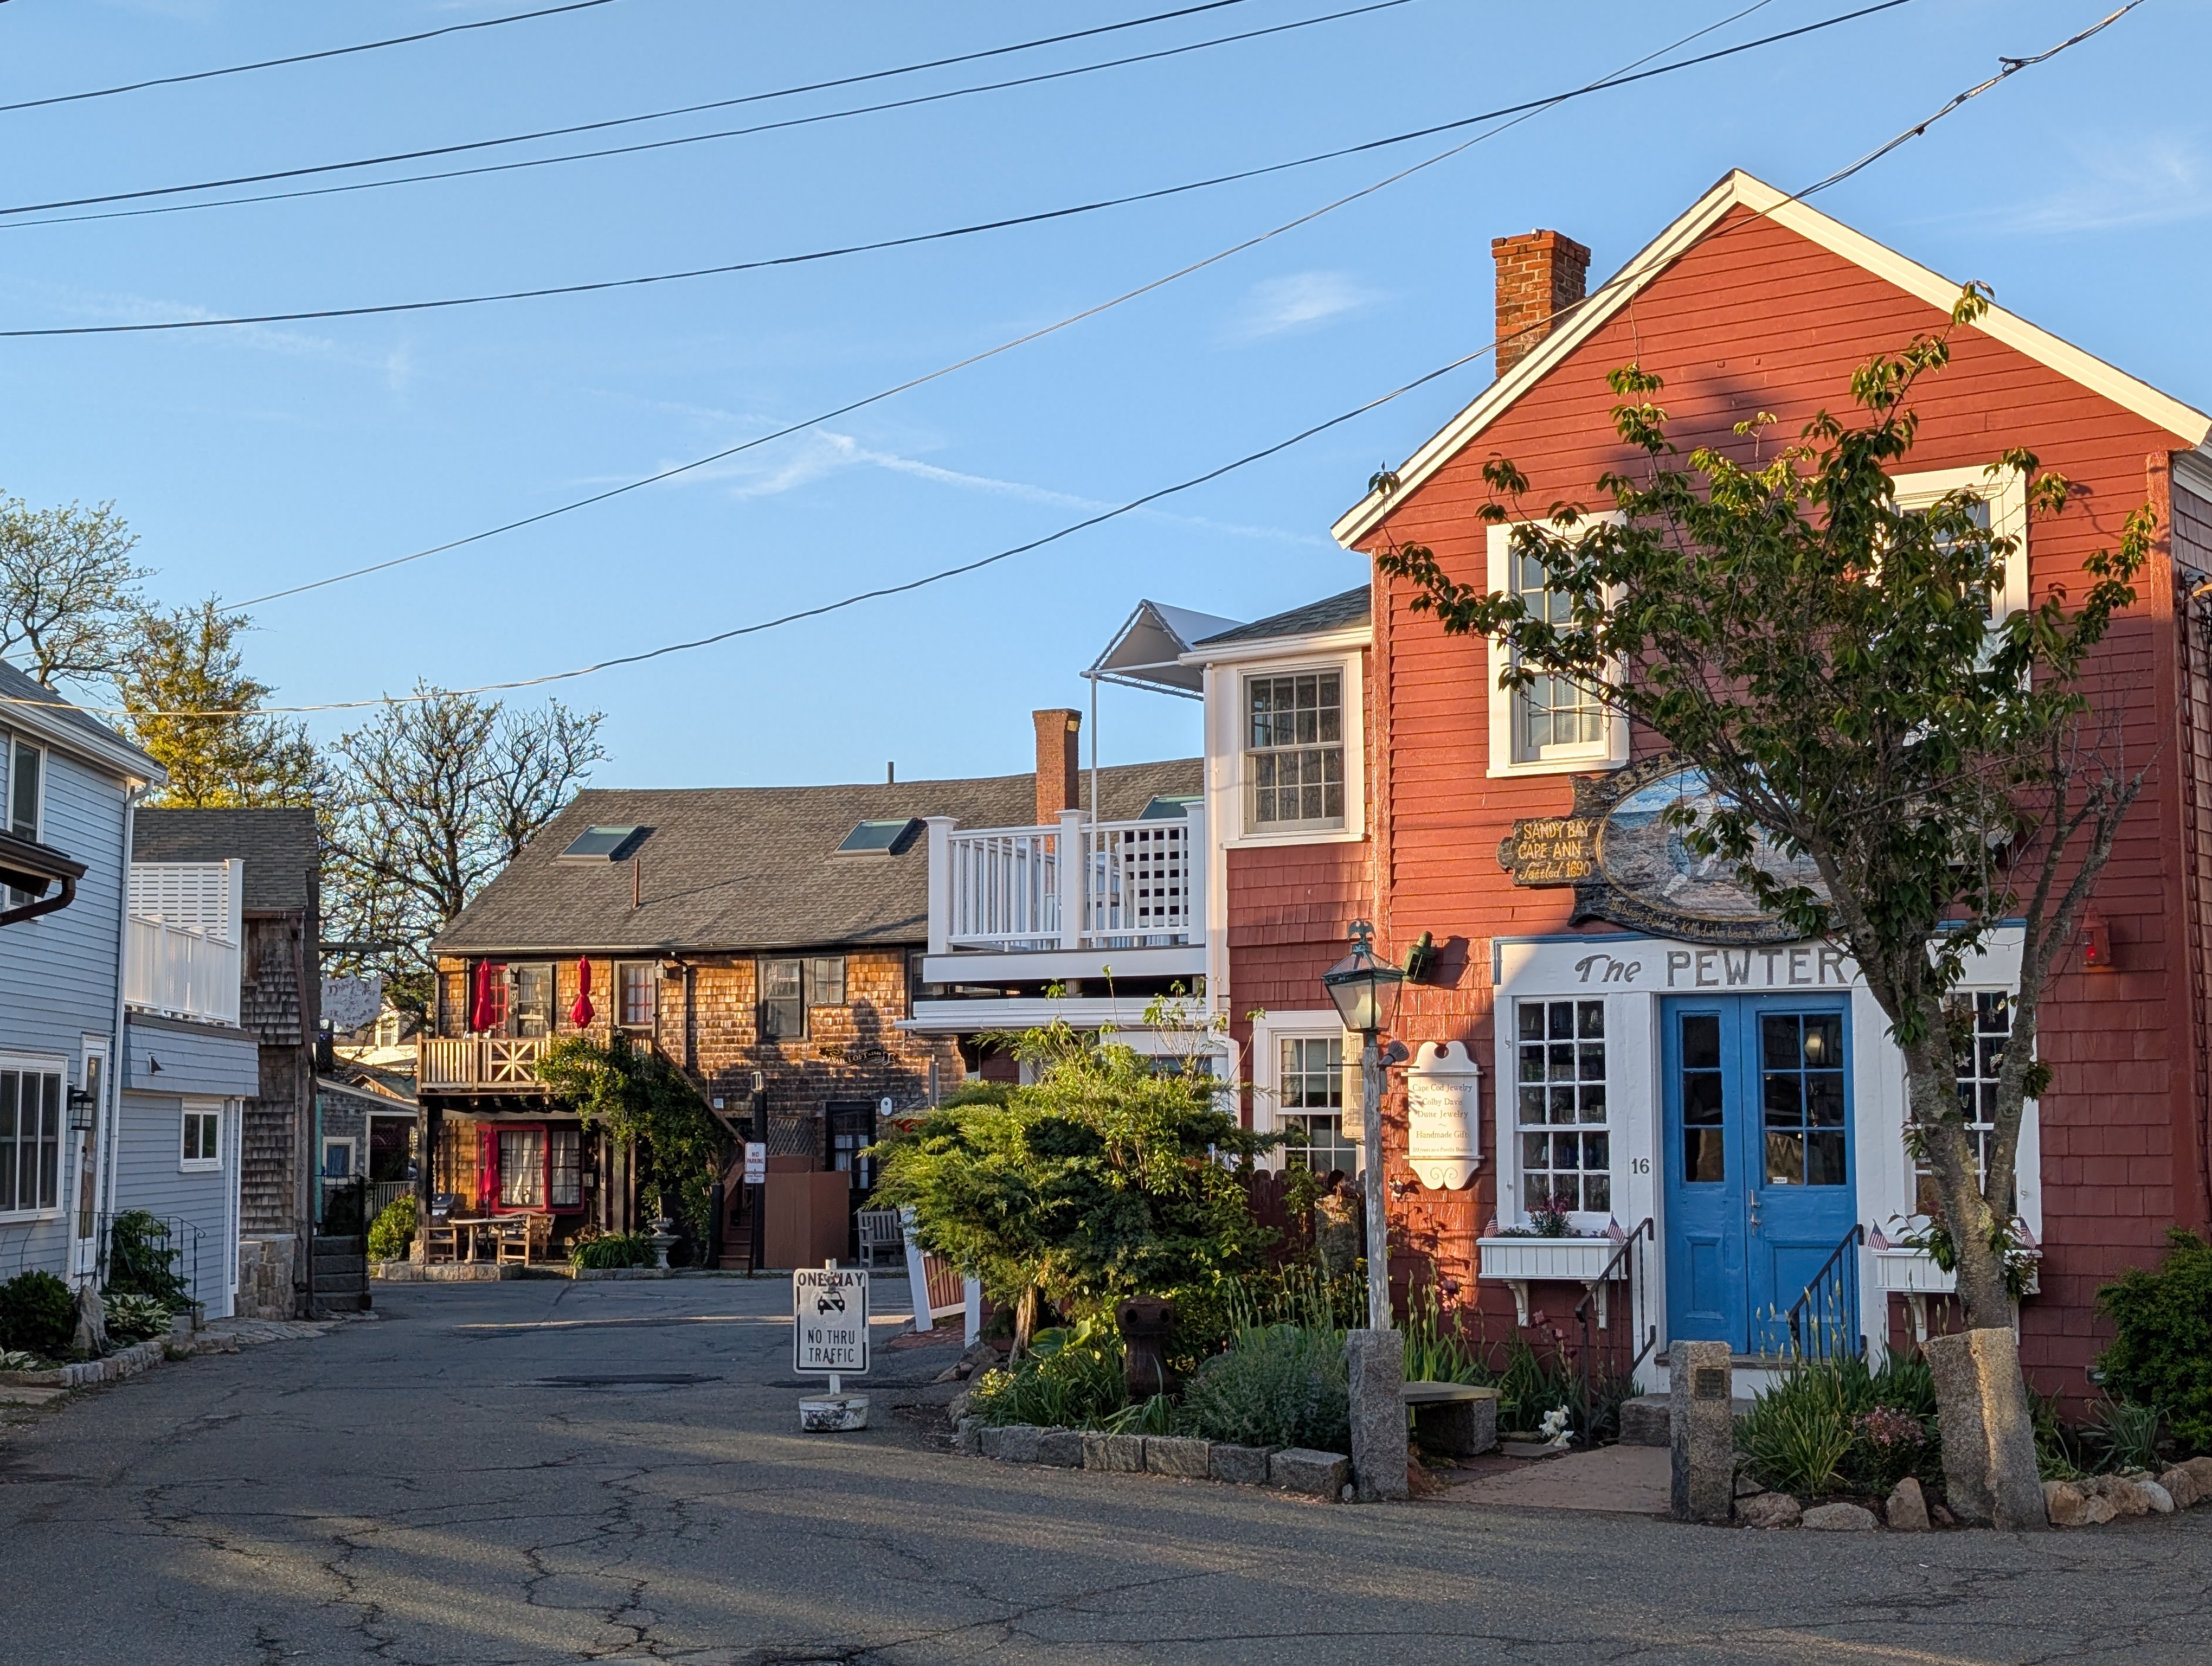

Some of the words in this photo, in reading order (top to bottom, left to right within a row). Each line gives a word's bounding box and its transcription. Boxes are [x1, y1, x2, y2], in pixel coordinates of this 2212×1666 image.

[1524, 822, 1566, 840] SANDY
[1567, 819, 1593, 838] BAY
[1518, 843, 1547, 860] CAPE
[1553, 841, 1581, 858] ANN
[1565, 861, 1591, 877] 1690
[1574, 954, 1641, 982] The
[1667, 947, 1848, 986] PEWTER
[847, 1052, 868, 1063] LOFT
[1412, 1084, 1429, 1092] Cape
[1446, 1084, 1472, 1092] Jewelry
[1422, 1098, 1442, 1106] Colby
[1440, 1110, 1468, 1119] Jewelry
[1631, 1158, 1649, 1174] 16
[798, 1272, 825, 1286] ONE
[808, 1329, 822, 1344] NO
[827, 1330, 855, 1344] THRU
[809, 1348, 854, 1362] TRAFFIC
